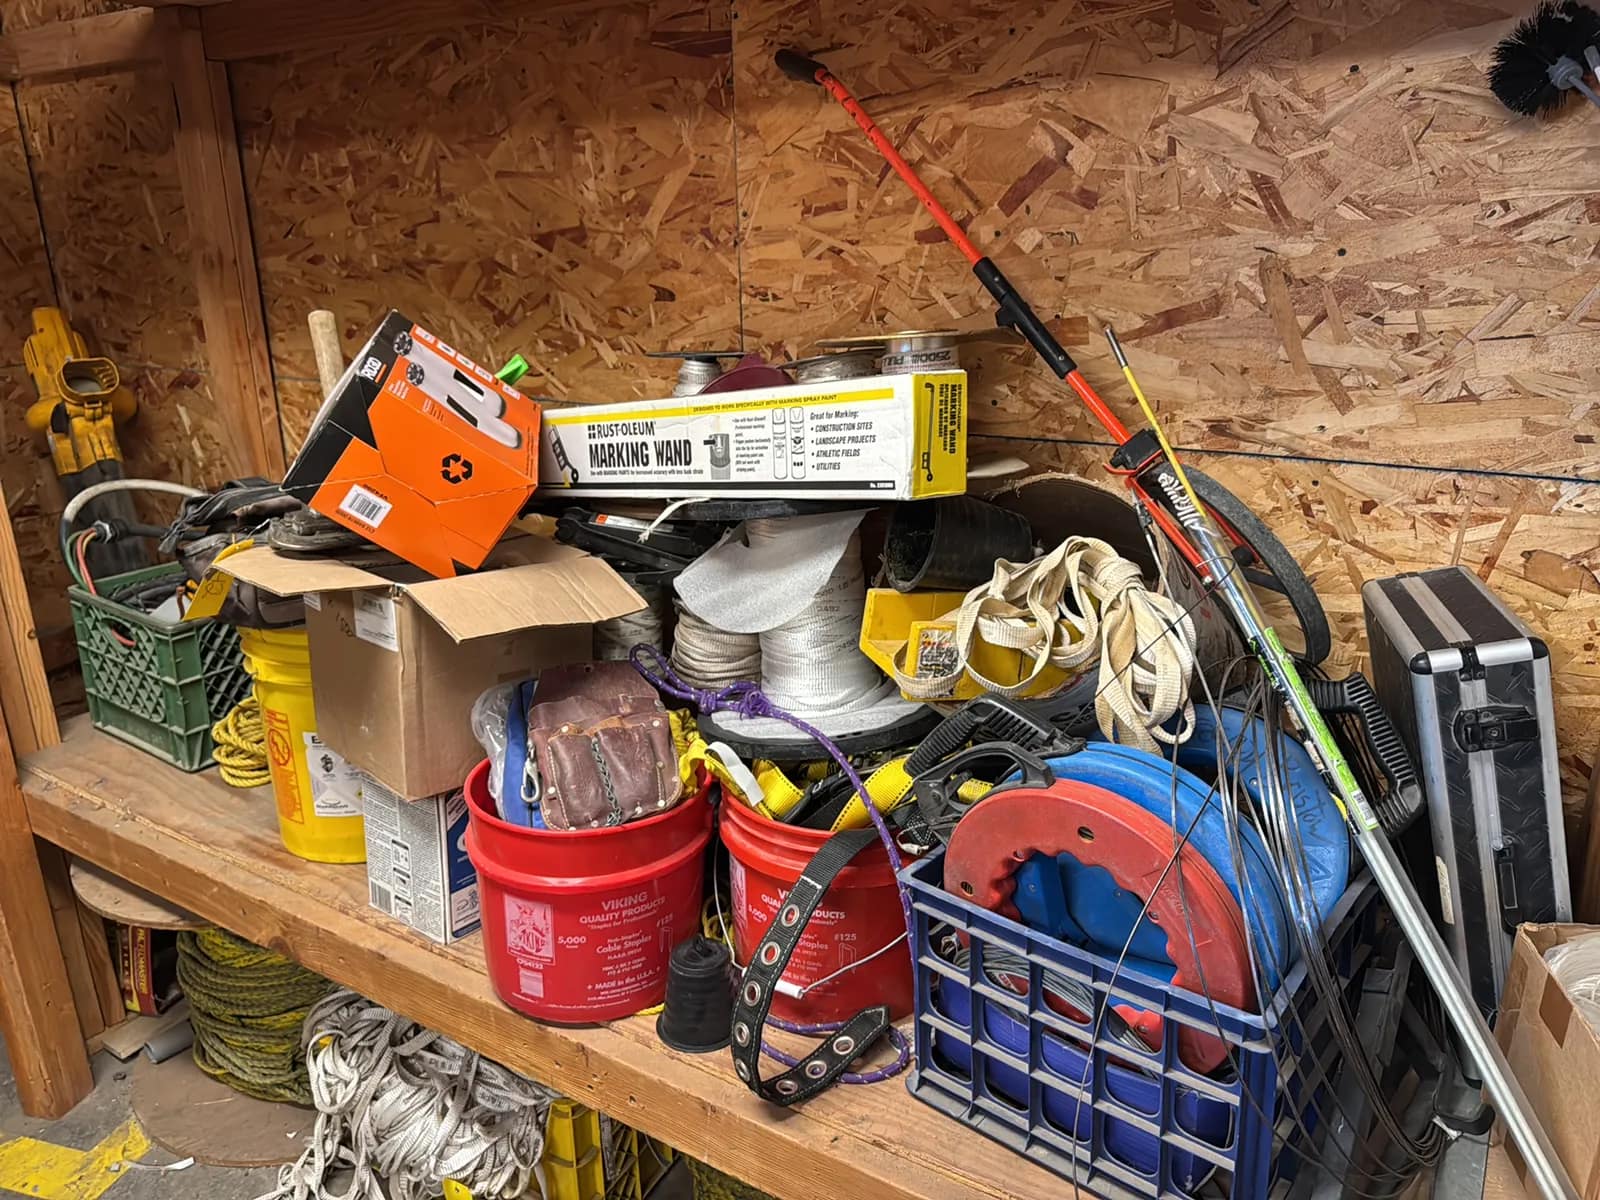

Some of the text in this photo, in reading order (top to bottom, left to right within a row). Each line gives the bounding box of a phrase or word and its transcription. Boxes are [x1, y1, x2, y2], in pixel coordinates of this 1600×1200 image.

[779, 398, 802, 406] MARKING
[810, 410, 859, 421] Great for Marking:
[597, 421, 656, 439] RUST-OLEUM
[815, 422, 873, 433] CONSTRUCTION SITES
[816, 435, 877, 446] LANDSCAPE PROJECTS
[949, 429, 957, 454] WAND
[589, 439, 692, 468] MARKING WAND
[816, 448, 860, 458] ATHLETIC FIELDS
[816, 462, 841, 471] UTILITIES
[601, 891, 648, 911] VIKING
[579, 896, 666, 924] QUALITY PRODUCTS
[761, 894, 846, 920] QUAL DUCTS
[557, 936, 587, 945] 5,000
[834, 933, 857, 941] #125
[596, 942, 622, 954] Cable
[594, 979, 616, 990] MADE
